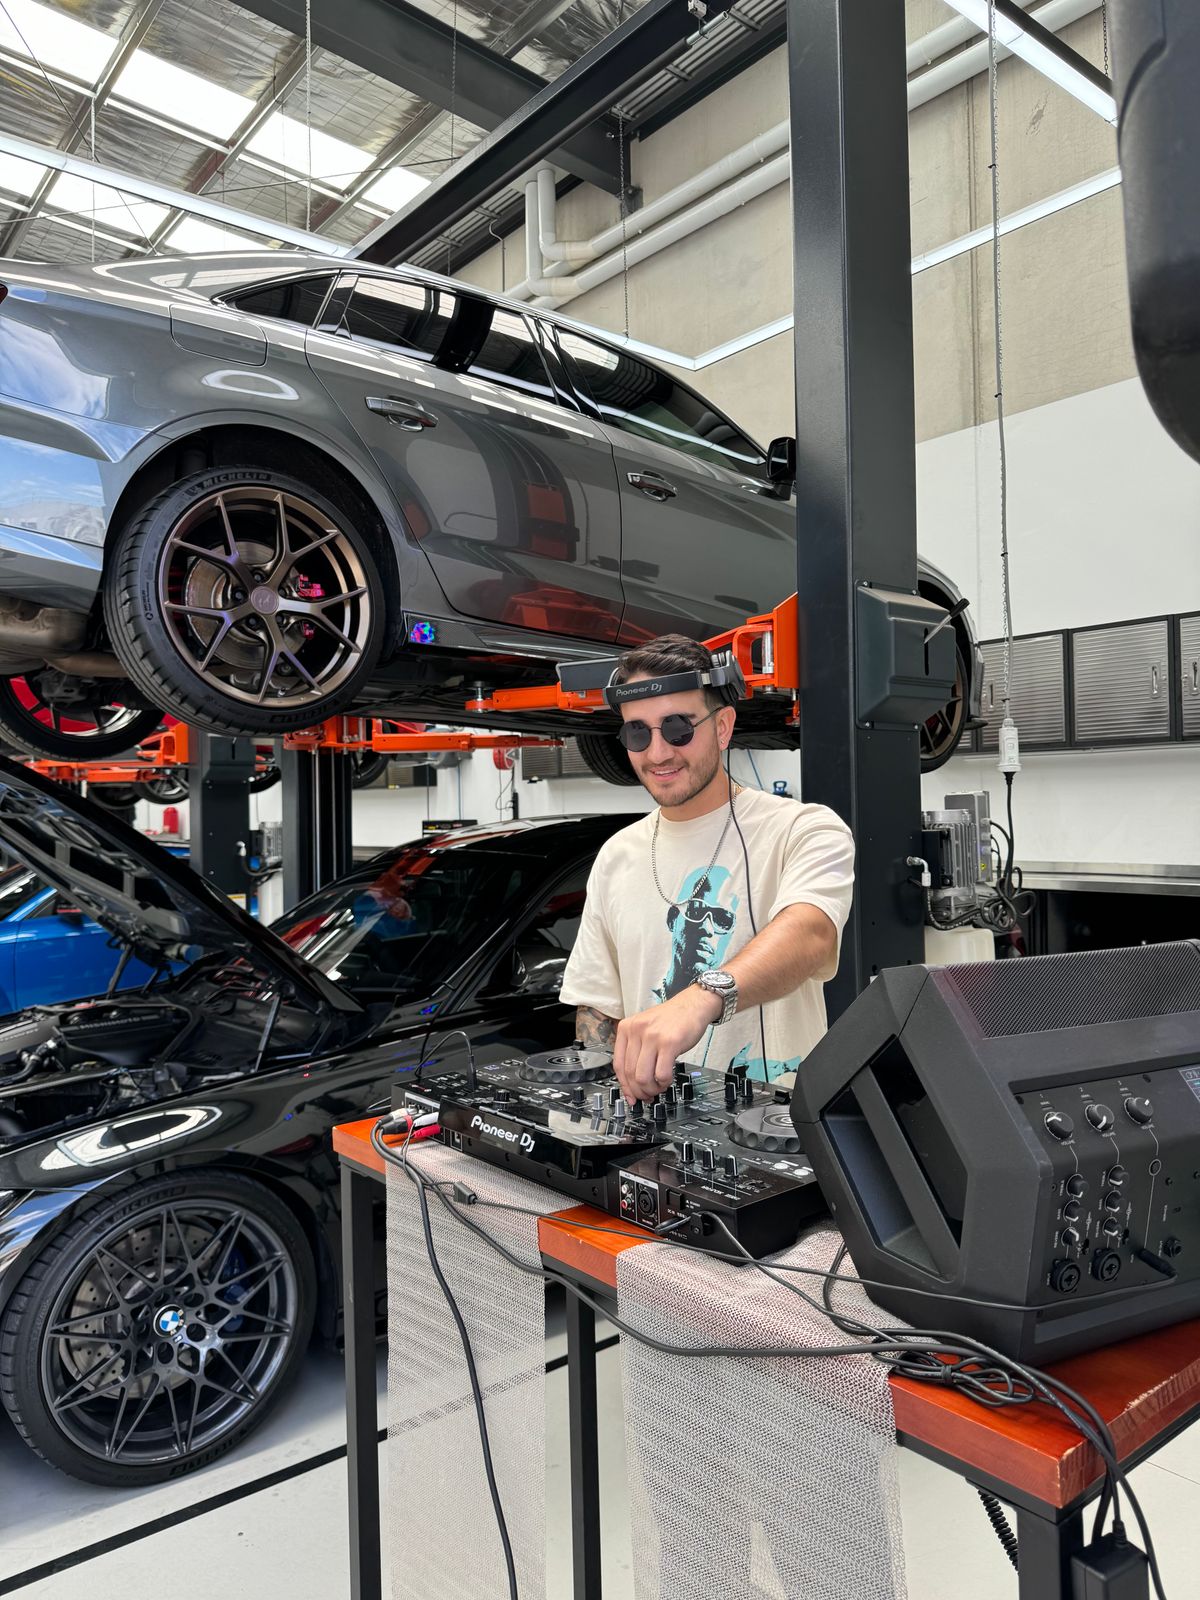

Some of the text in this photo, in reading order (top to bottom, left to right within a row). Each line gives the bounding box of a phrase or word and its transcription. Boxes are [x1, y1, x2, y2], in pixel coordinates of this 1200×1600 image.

[203, 473, 268, 488] MICHELIN
[615, 686, 649, 697] Pioneer
[470, 1115, 519, 1142] Pioneer
